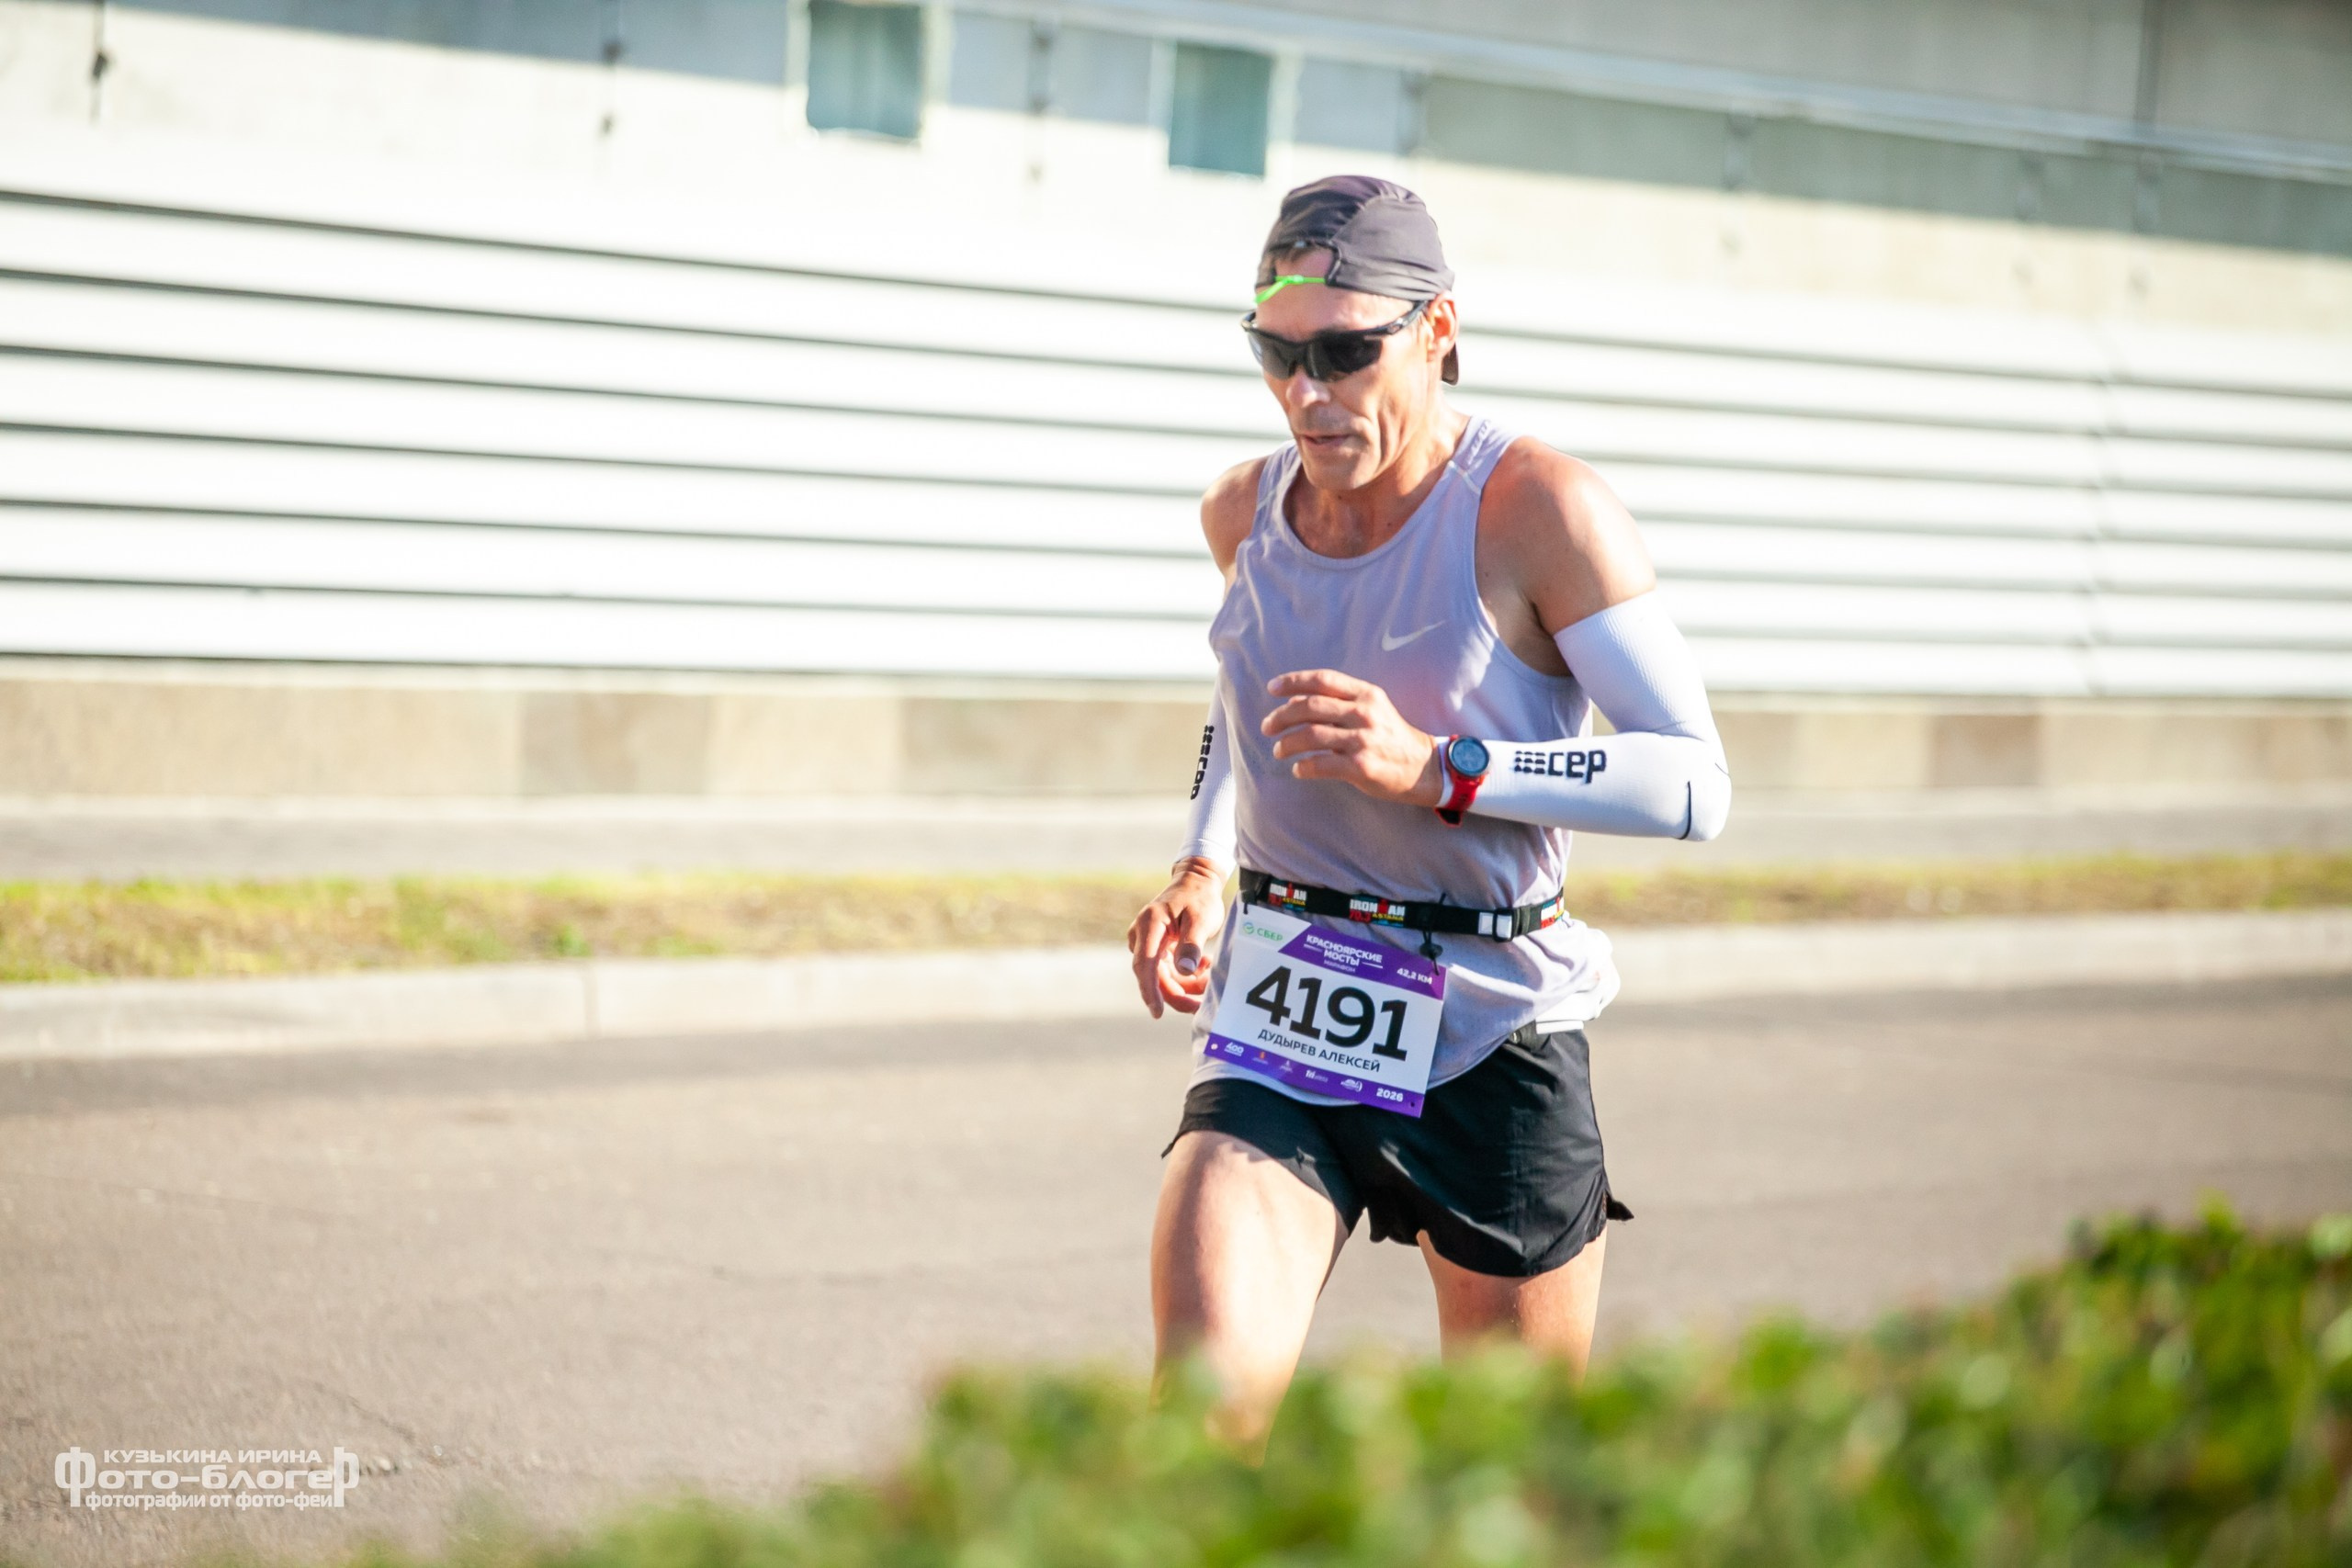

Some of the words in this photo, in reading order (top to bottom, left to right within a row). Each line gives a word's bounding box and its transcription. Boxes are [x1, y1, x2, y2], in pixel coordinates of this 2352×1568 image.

[1548, 749, 1607, 784] cep
[1257, 928, 1283, 942] СБЕР
[1306, 934, 1384, 963] КРАСНОЯРСКИЕ
[1323, 949, 1360, 966] МОСТЫ
[1245, 965, 1408, 1062] 4191
[1258, 1029, 1316, 1056] ДУДЫРЕВ
[1318, 1049, 1381, 1073] АЛЕКСЕЙ
[1376, 1088, 1404, 1102] 2026
